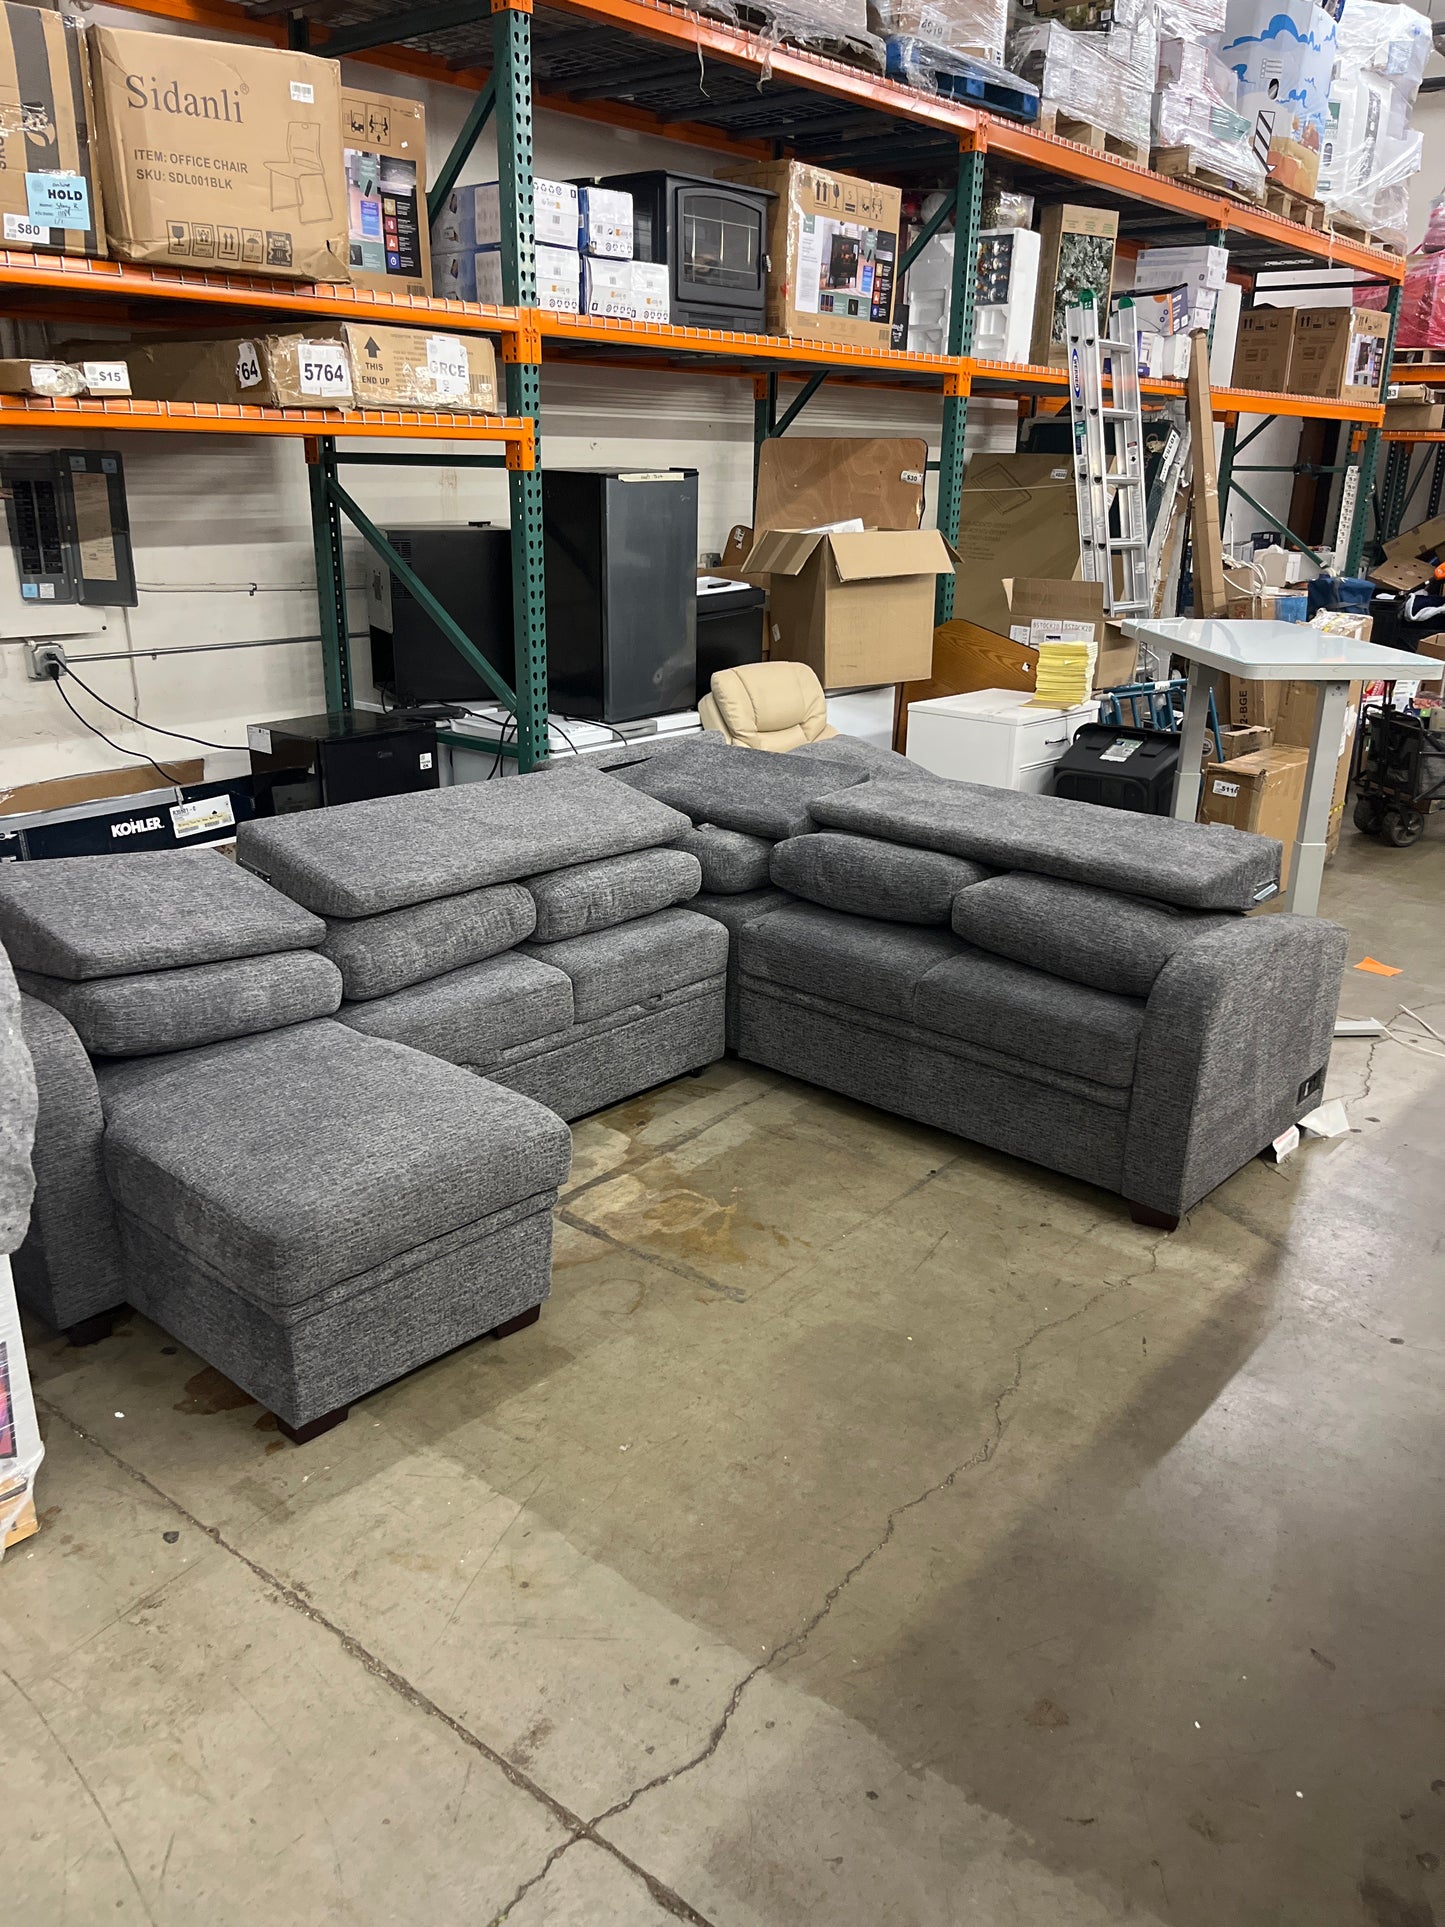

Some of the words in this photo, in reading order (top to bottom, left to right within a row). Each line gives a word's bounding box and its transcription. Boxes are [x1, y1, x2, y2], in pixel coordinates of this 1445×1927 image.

[125, 74, 244, 124] Sidanli
[134, 149, 167, 163] ITEM:
[170, 153, 211, 169] OFFICE
[213, 160, 249, 174] CHAIR
[136, 169, 166, 182] SKU:
[168, 172, 233, 190] SDL001BLK
[47, 188, 83, 201] HOLD
[304, 363, 344, 382] 5764
[365, 362, 384, 371] THIS
[429, 360, 466, 378] GRCE
[99, 371, 121, 383] $15
[361, 376, 377, 384] END
[379, 377, 390, 386] UP
